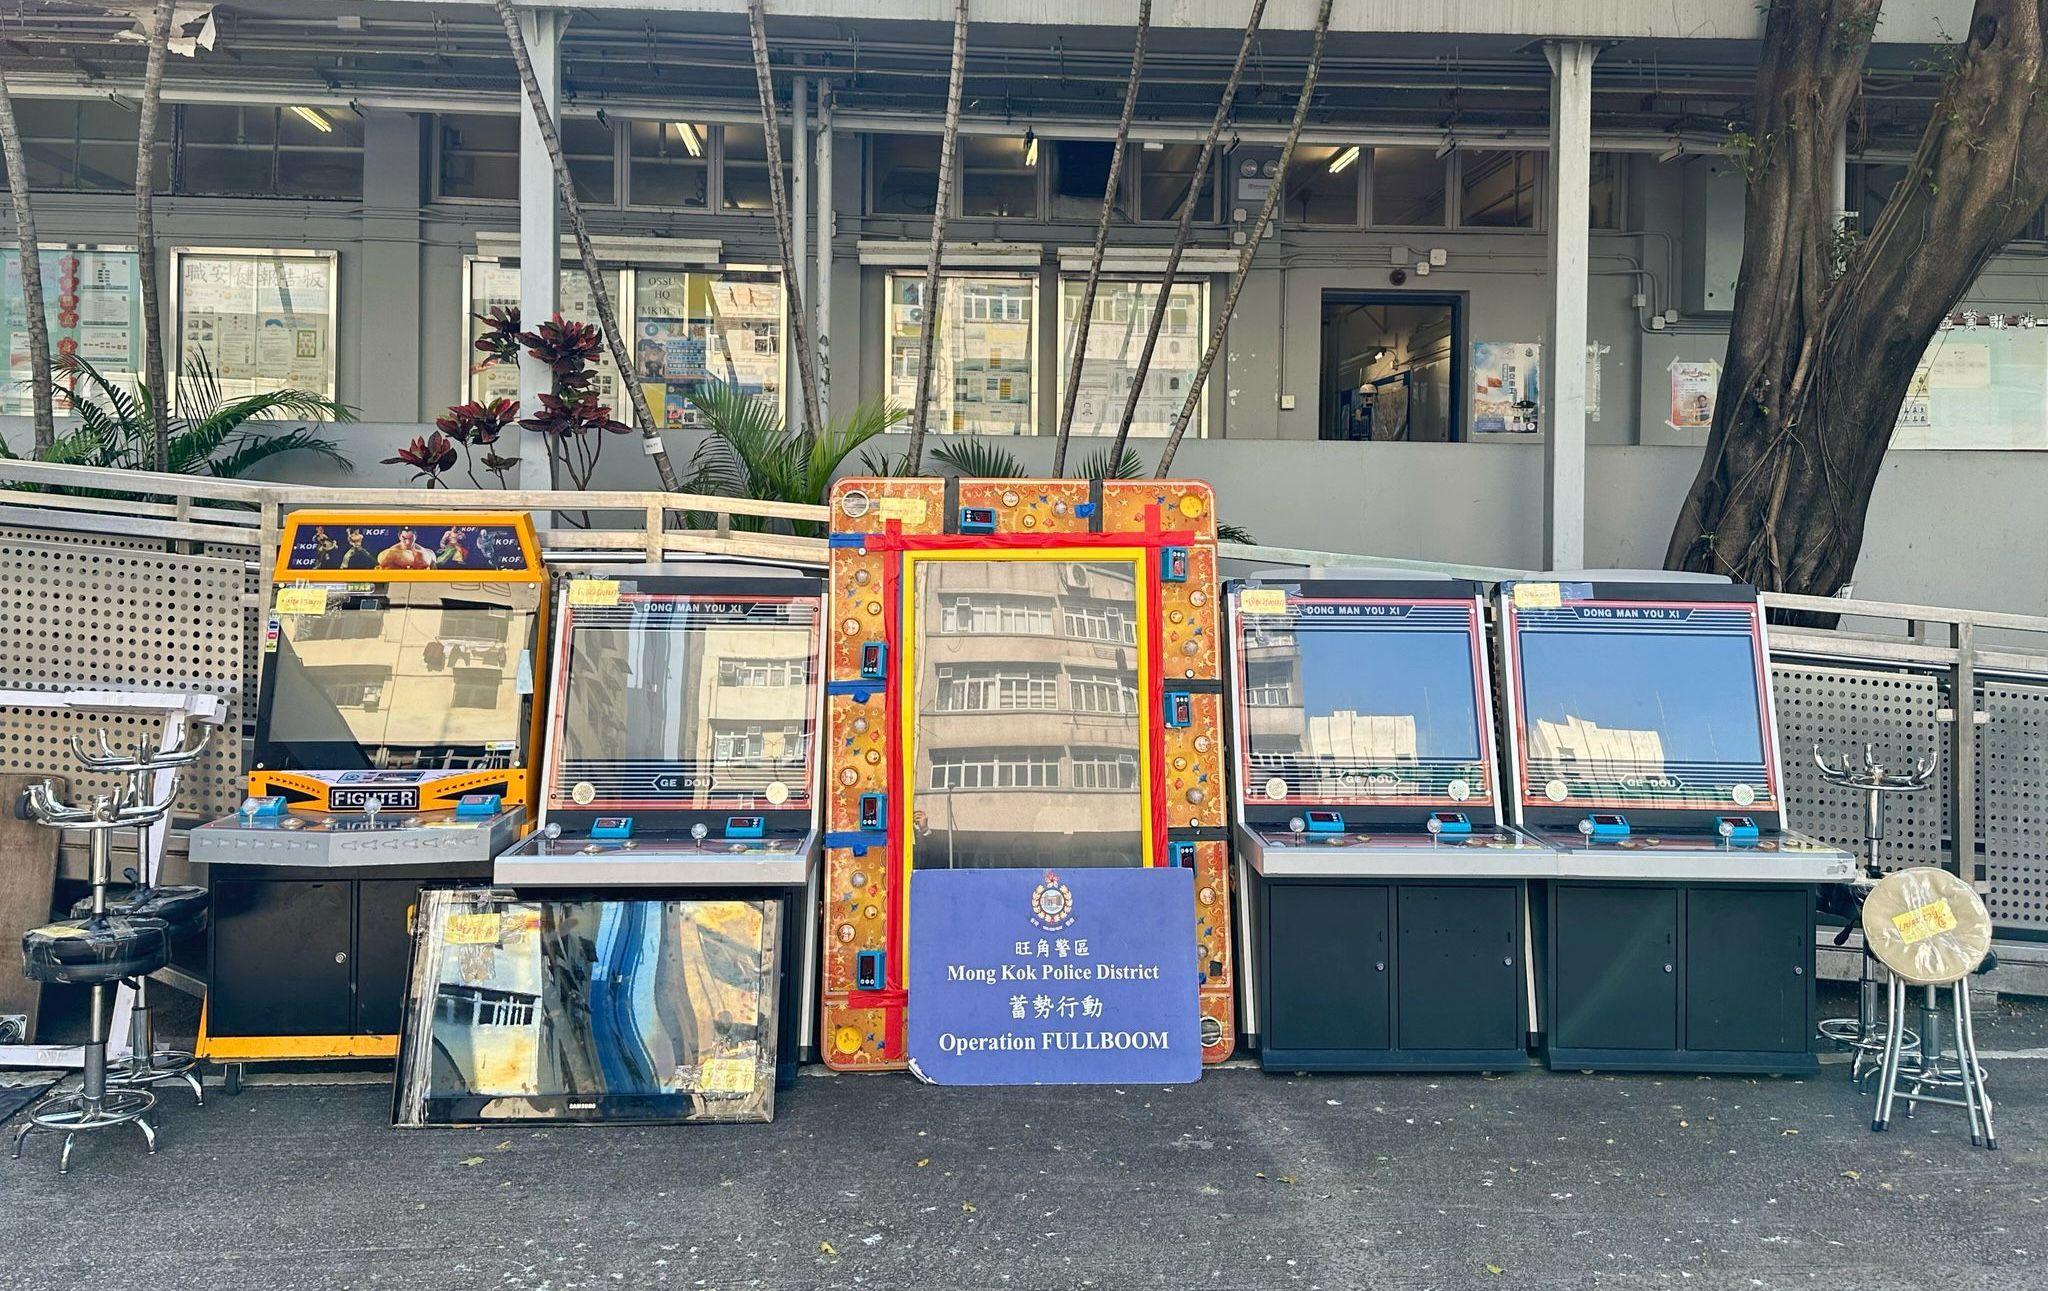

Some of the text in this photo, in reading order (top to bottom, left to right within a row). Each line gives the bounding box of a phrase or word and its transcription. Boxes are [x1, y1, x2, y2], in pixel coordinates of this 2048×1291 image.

[648, 277, 676, 286] OSSU
[655, 290, 670, 300] HQ
[365, 528, 386, 536] KOF
[495, 538, 515, 546] KOF
[643, 603, 743, 614] DONG MAN YOU XI
[1306, 606, 1400, 615] DONG MAN YOU XI
[1583, 608, 1680, 619] DONG MAN YOU XI
[659, 778, 711, 788] GE DOU
[1345, 774, 1394, 784] GE DOU
[1627, 777, 1677, 788] GE DOU
[1015, 938, 1091, 959] 旺角警區
[947, 964, 1160, 984] Mong Kok Police District
[1009, 994, 1103, 1020] 蓄勢行動
[939, 1031, 1169, 1056] Operation FULLBOOM
